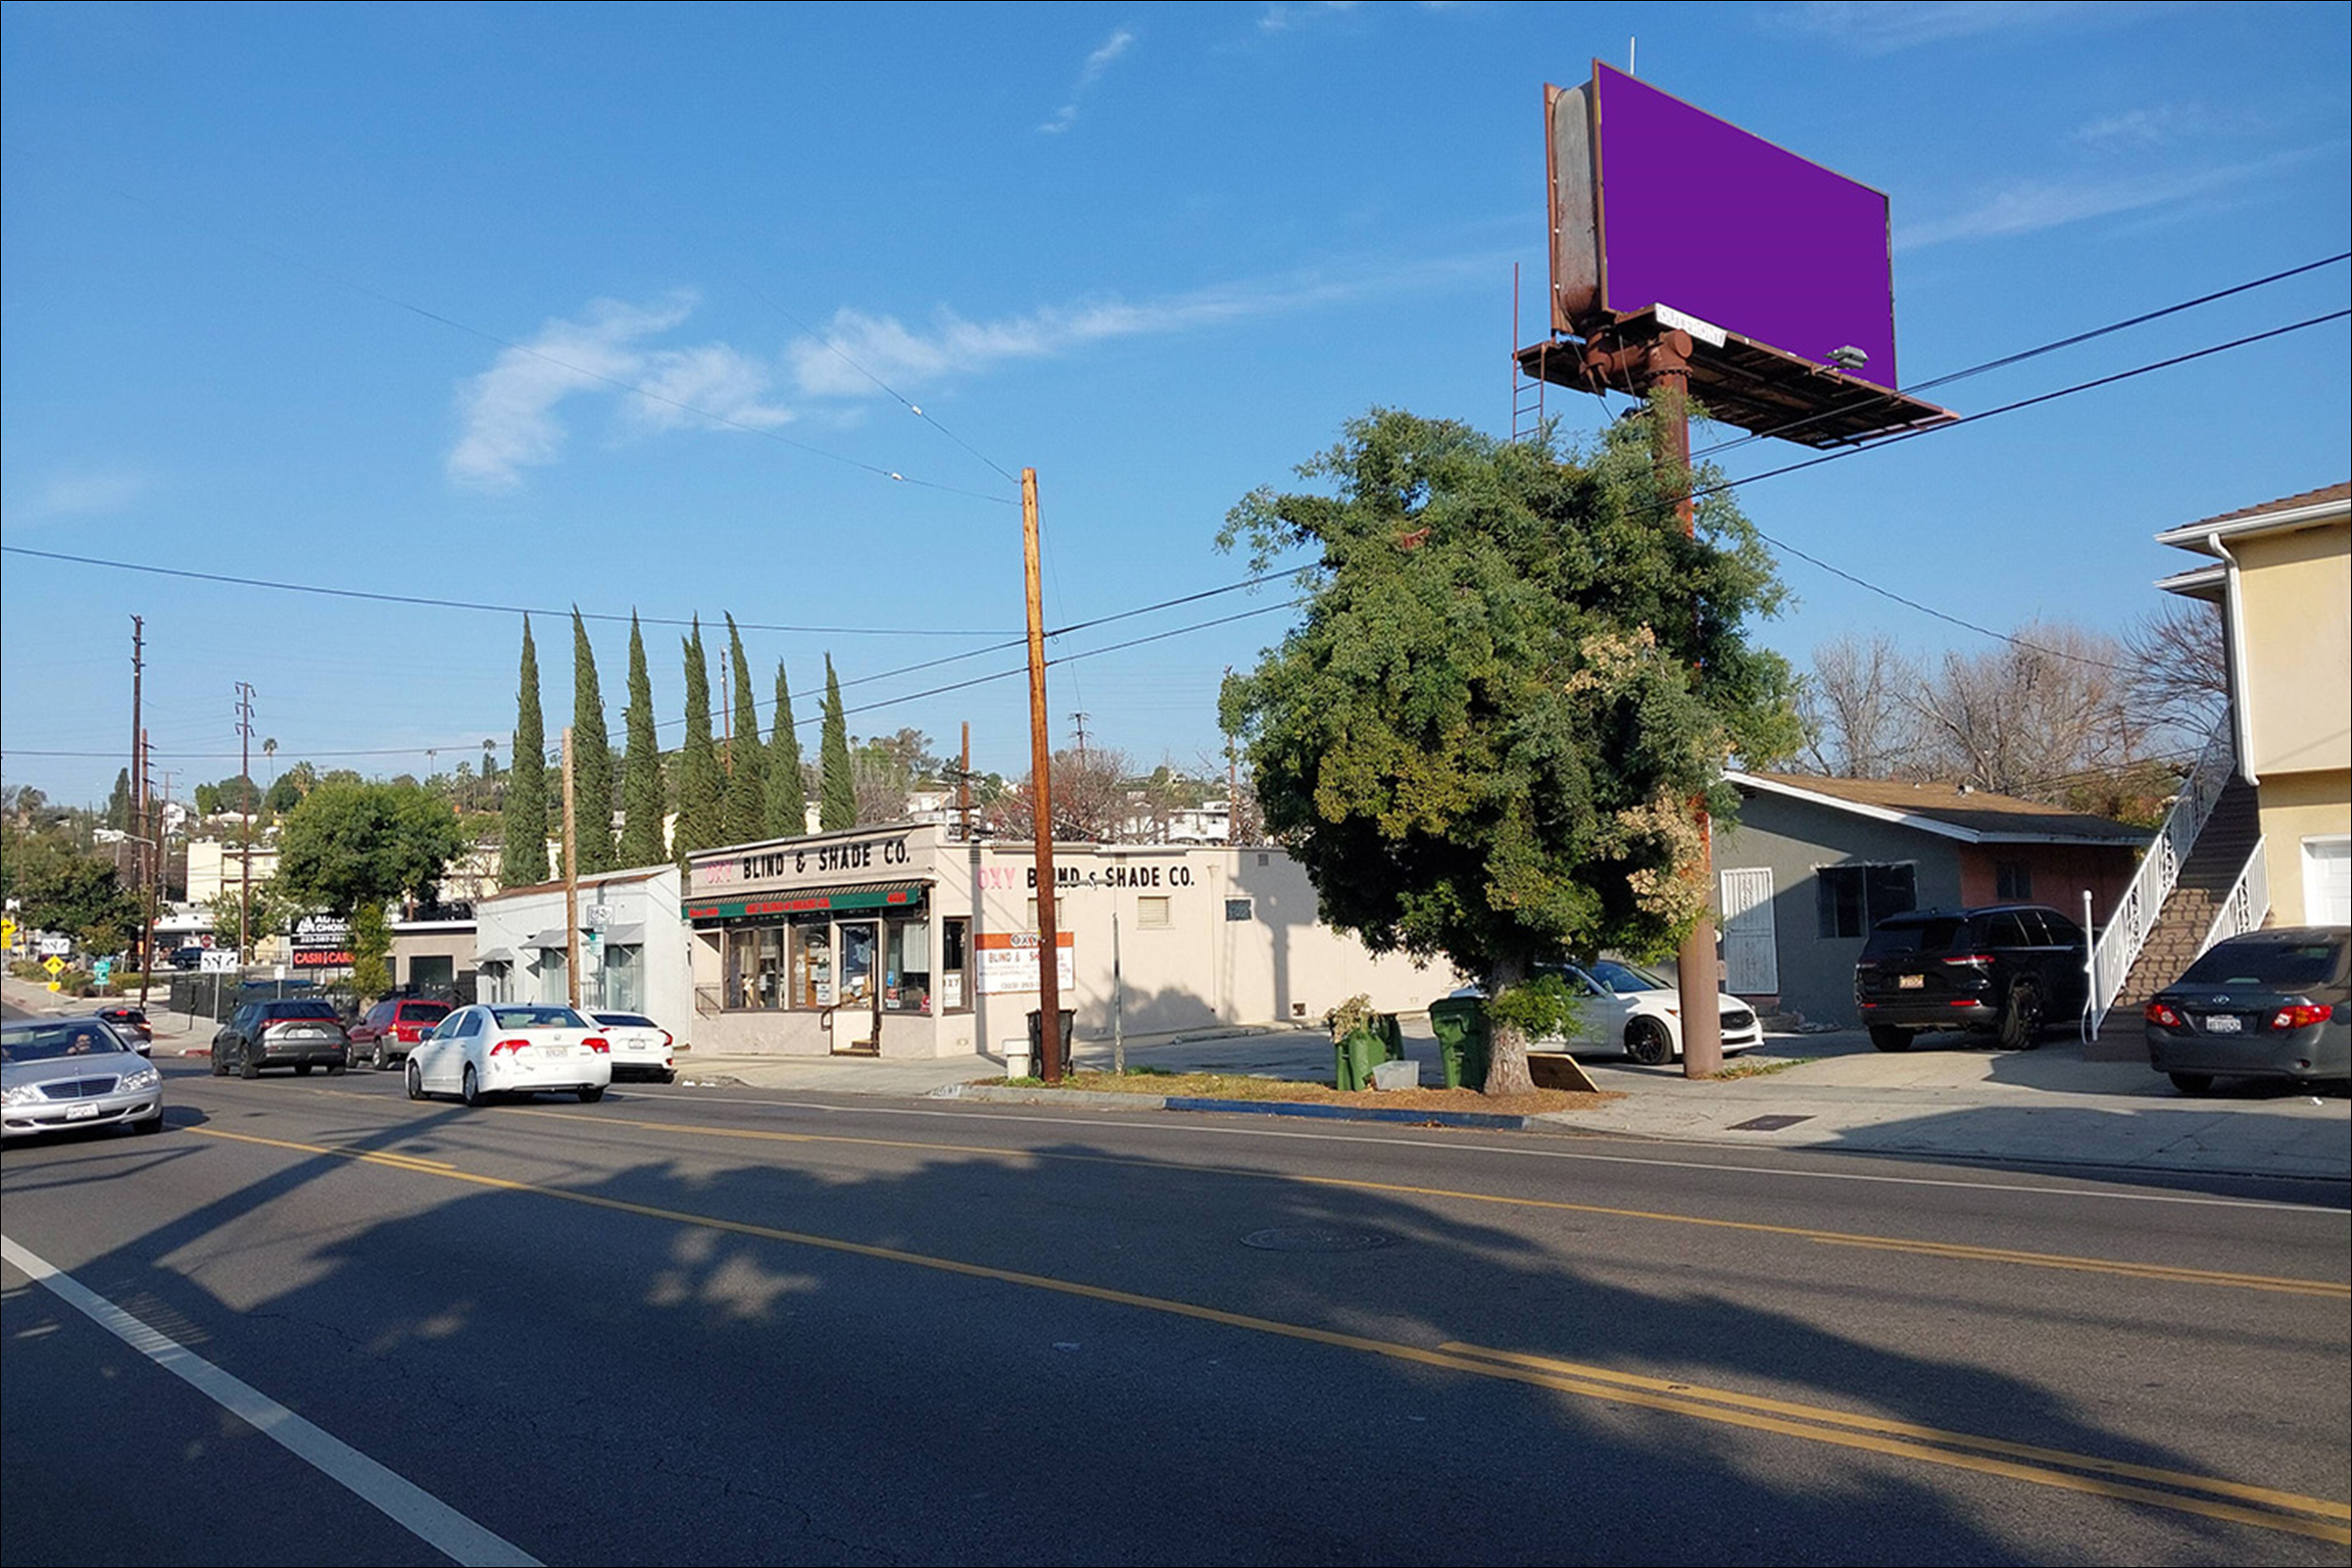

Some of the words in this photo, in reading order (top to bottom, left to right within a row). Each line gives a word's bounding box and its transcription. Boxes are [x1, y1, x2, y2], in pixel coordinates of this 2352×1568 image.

[744, 854, 785, 879] BLIND
[796, 852, 807, 873] &
[819, 844, 871, 871] SHADE
[884, 840, 910, 863] CO.
[977, 867, 1015, 890] OXY
[1027, 867, 1080, 888] BIND
[1105, 866, 1159, 887] SHADE
[1169, 865, 1195, 887] CO.
[294, 953, 322, 964] CASH
